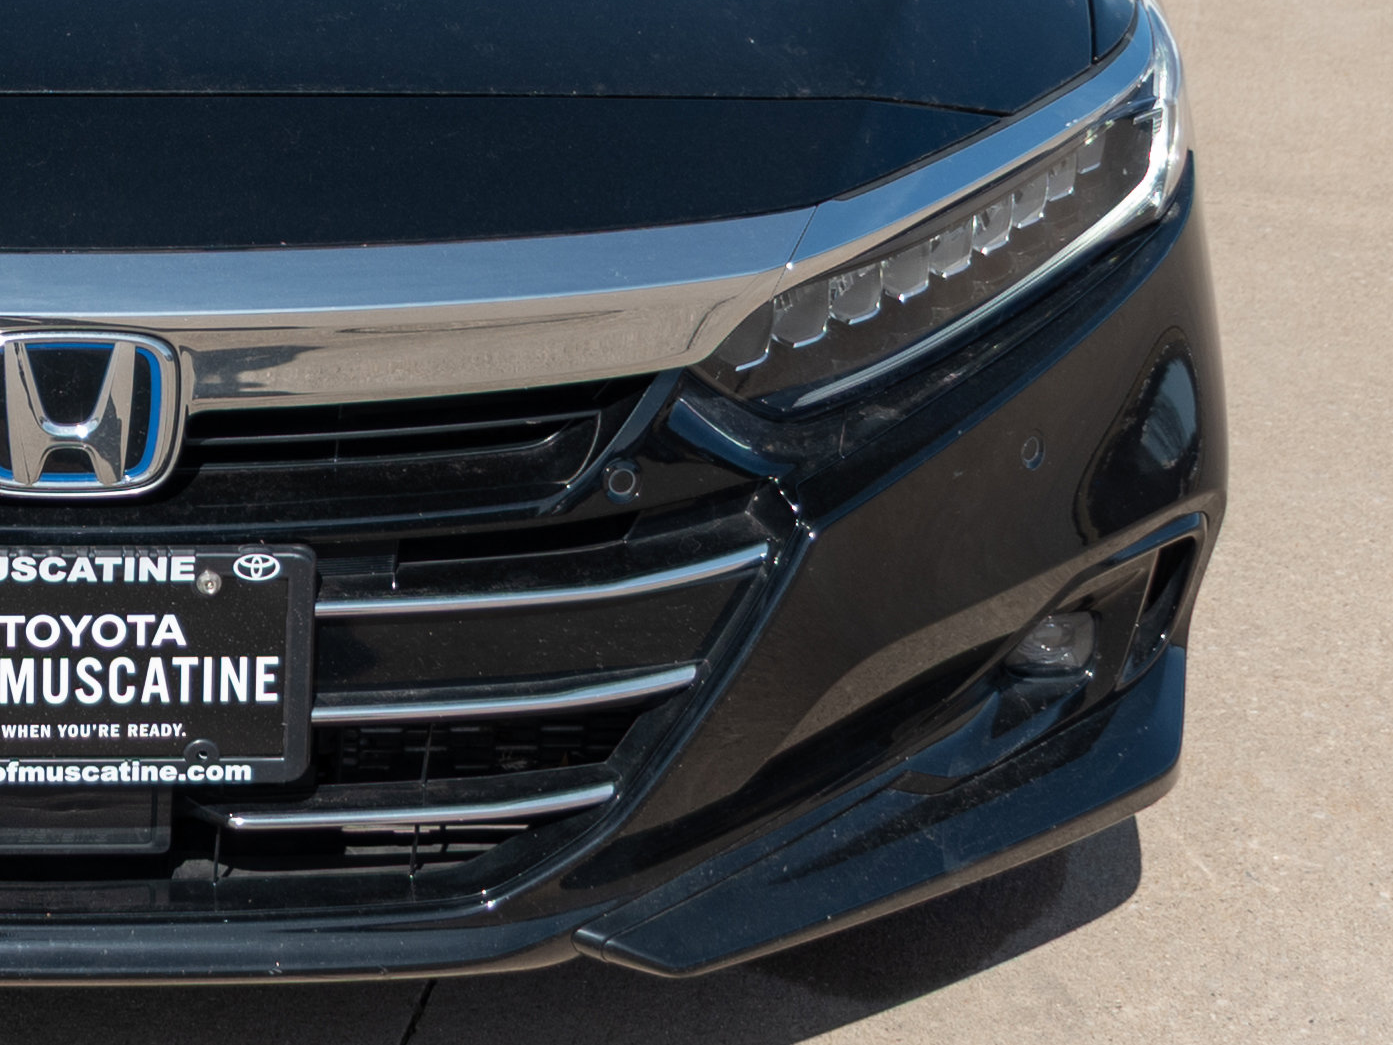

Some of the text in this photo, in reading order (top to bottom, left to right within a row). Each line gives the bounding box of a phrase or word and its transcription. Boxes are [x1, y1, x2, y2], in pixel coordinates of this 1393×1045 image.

[0, 655, 280, 705] MUSCATINE
[0, 722, 187, 739] WHEN YOU'RE READY.
